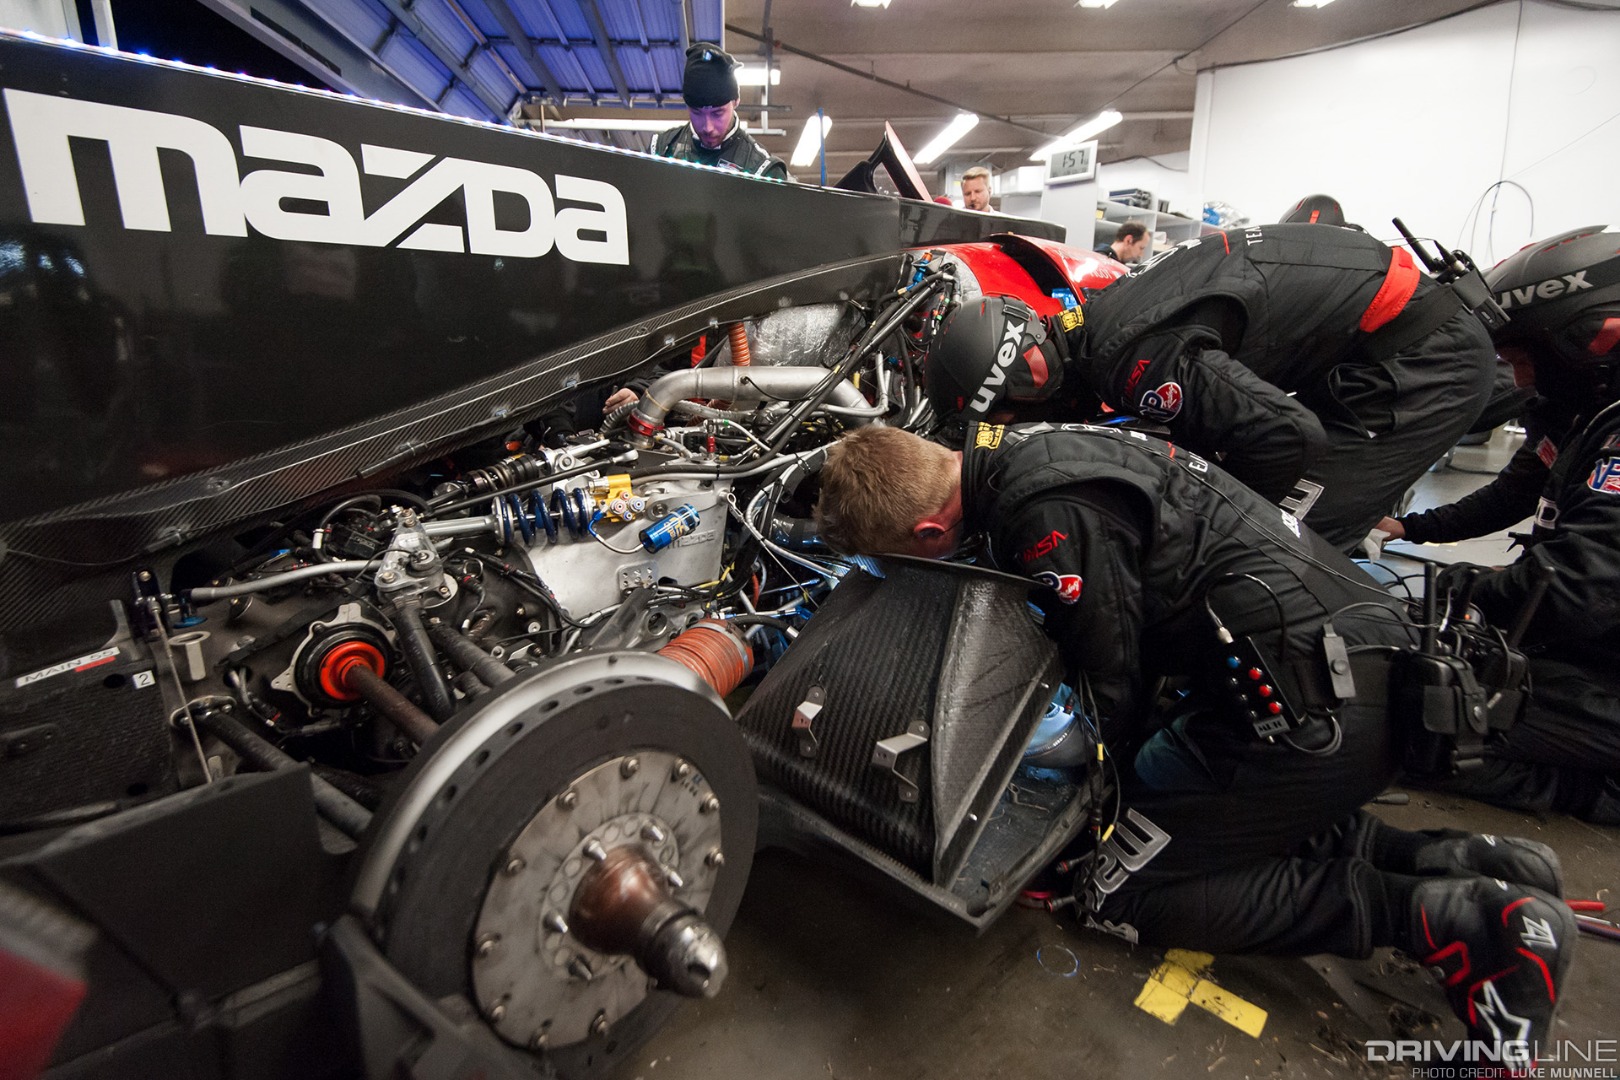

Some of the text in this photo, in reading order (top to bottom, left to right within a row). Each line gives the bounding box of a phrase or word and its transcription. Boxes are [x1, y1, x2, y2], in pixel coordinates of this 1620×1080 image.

[969, 320, 1025, 413] uvex
[24, 659, 82, 683] MAIN
[138, 673, 149, 686] 2
